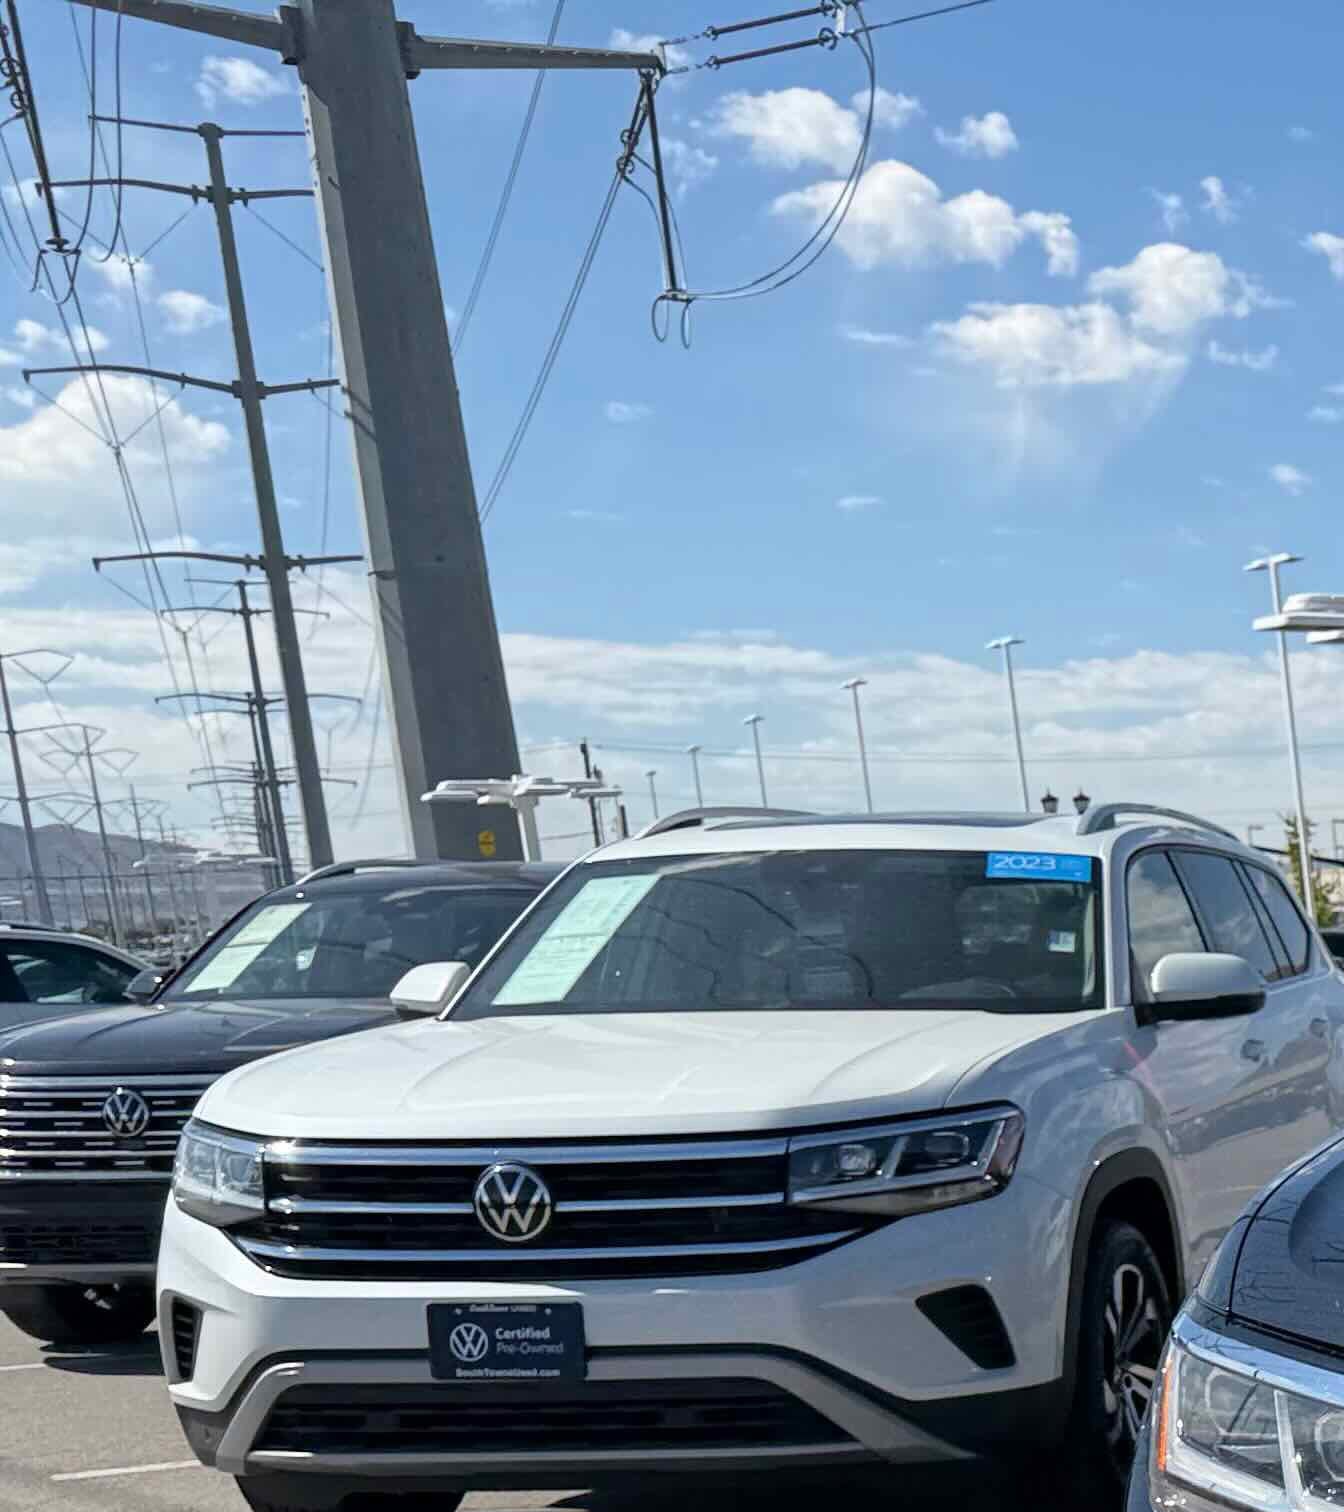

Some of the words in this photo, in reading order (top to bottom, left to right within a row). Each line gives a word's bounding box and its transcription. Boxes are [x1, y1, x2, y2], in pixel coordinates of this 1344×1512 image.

[993, 854, 1057, 870] 2023
[103, 1087, 149, 1137] VW
[474, 1163, 551, 1242] VW
[449, 1323, 488, 1362] VW
[495, 1327, 551, 1340] Certified
[496, 1342, 564, 1353] Pre-Owned
